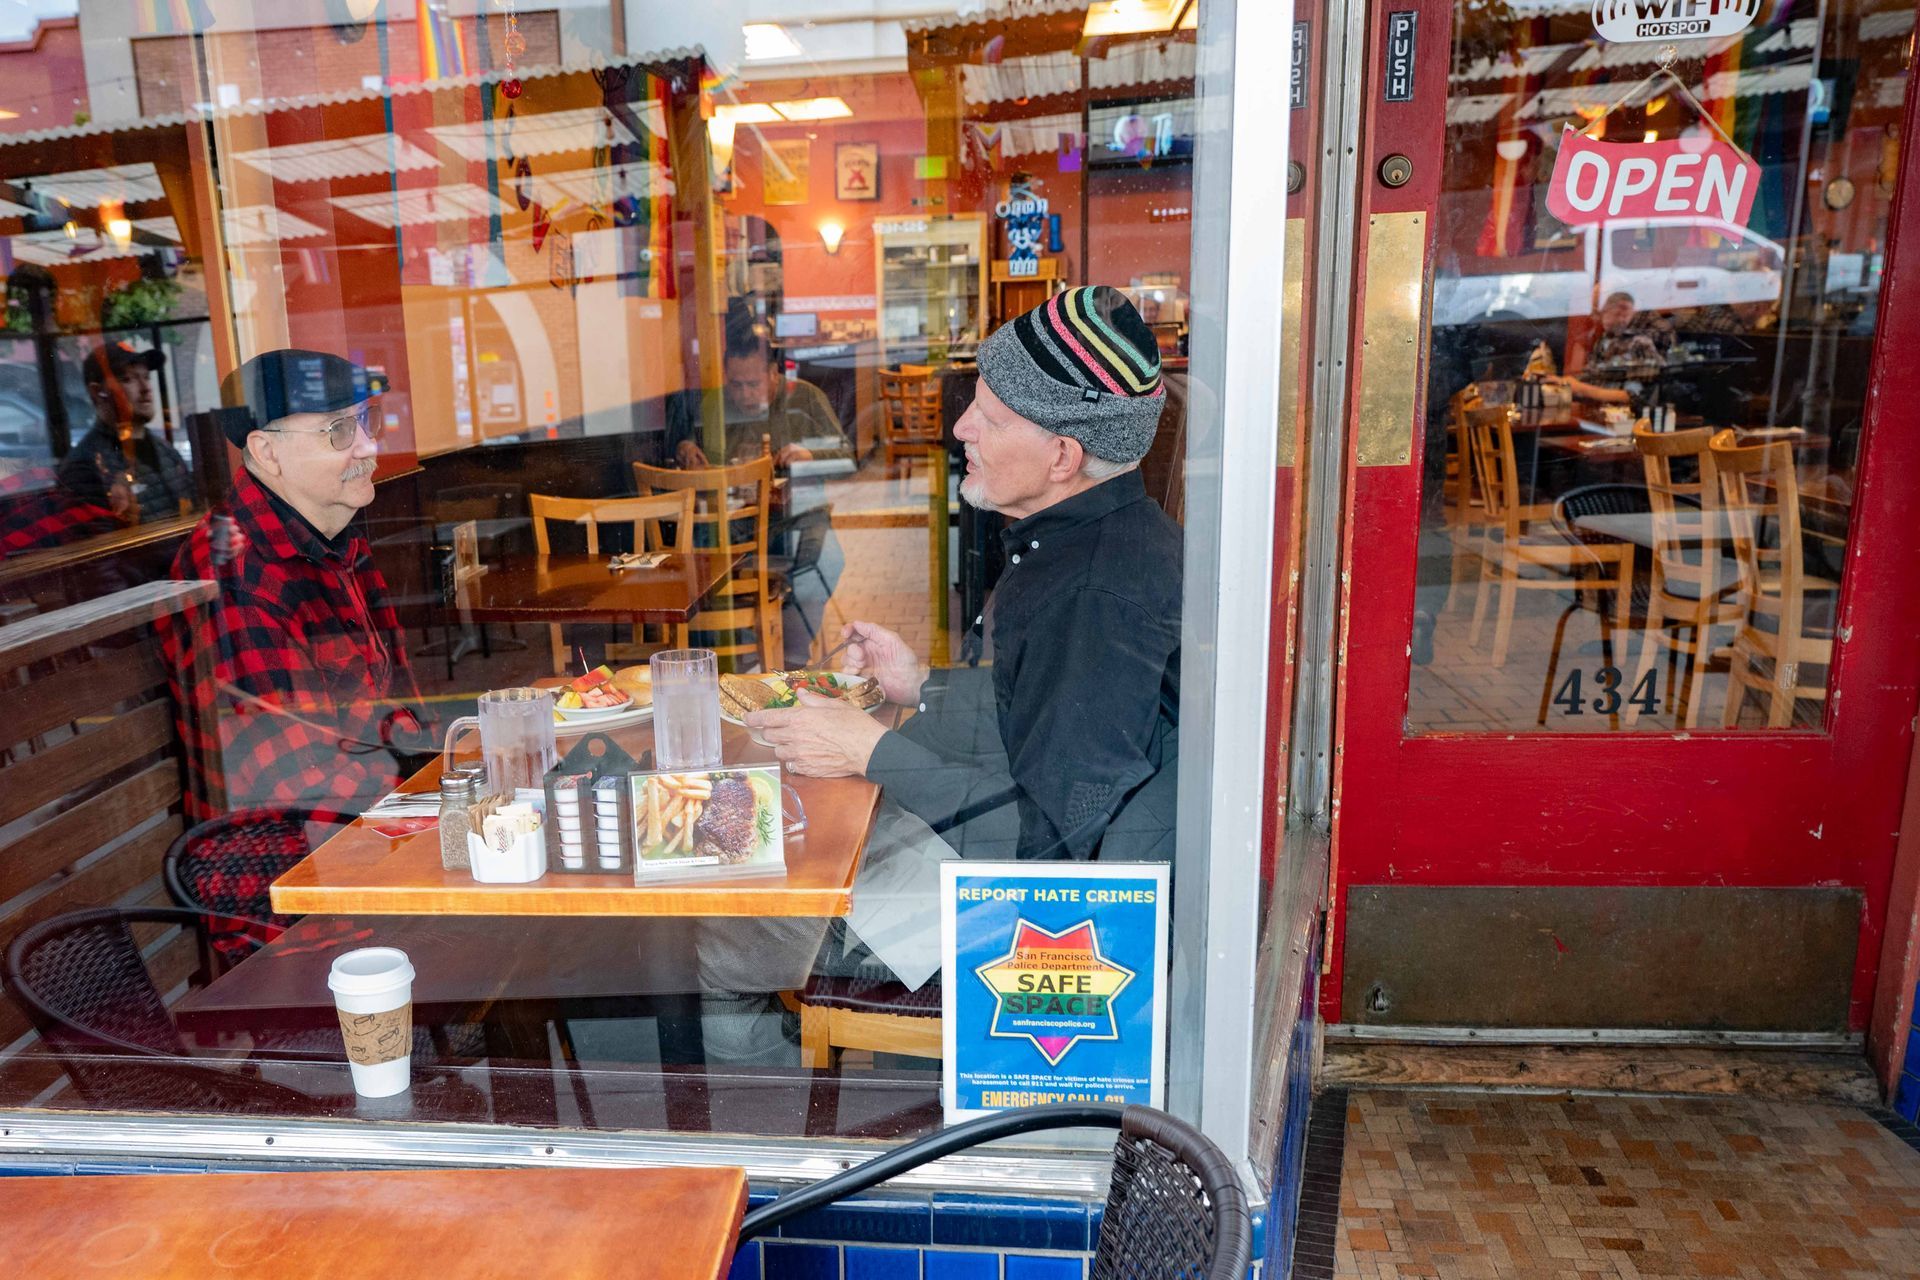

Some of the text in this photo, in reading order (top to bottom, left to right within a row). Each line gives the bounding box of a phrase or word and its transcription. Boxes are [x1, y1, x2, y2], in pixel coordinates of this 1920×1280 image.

[1639, 20, 1708, 36] HOTSPOT
[1392, 19, 1409, 96] PUSH
[1565, 150, 1747, 224] OPEN
[1554, 666, 1661, 715] 434
[959, 887, 1155, 903] REPORT HATE CRIMES
[1016, 951, 1093, 961] San Francisco
[1007, 961, 1103, 971] Police Department
[1017, 973, 1092, 993] SAFE
[1006, 994, 1103, 1016] SPACE
[1012, 1019, 1096, 1029] sanfranciscopolice.org
[981, 1091, 1065, 1107] EMERGENCY
